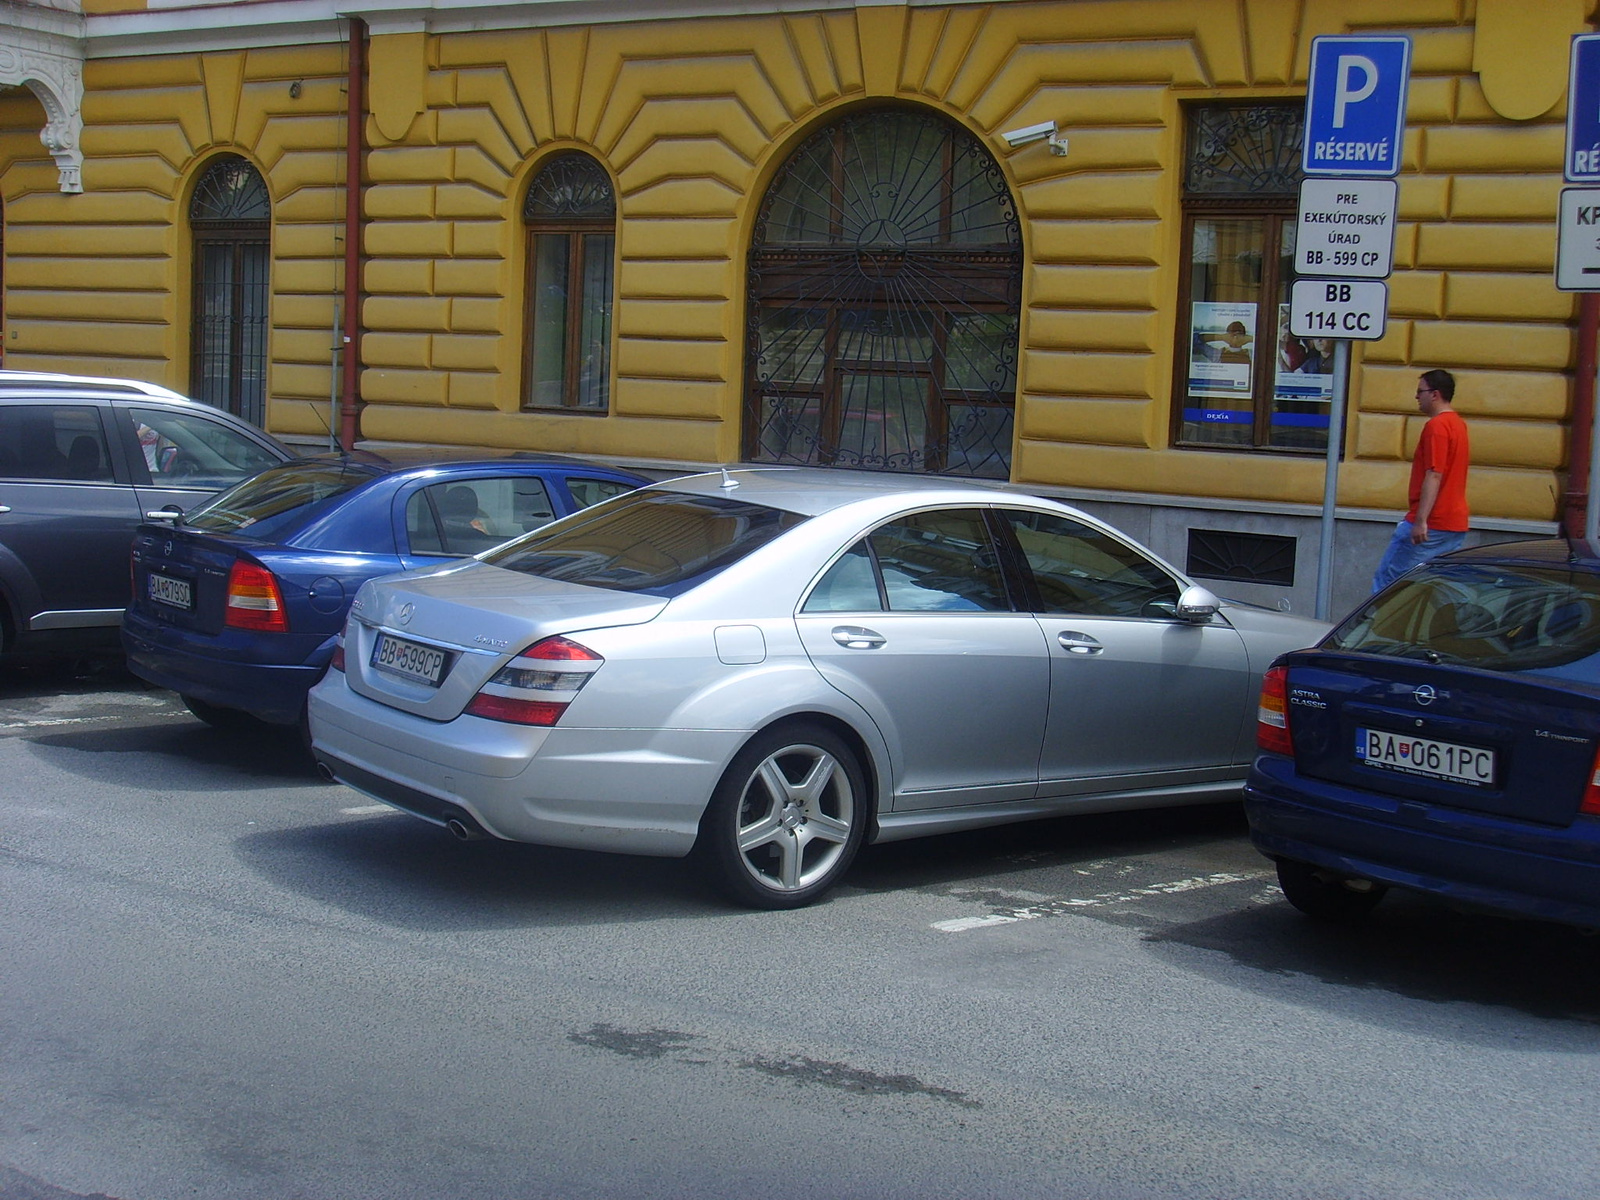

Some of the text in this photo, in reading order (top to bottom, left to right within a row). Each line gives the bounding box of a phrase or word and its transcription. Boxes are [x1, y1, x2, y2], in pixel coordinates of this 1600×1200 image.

[1332, 55, 1378, 128] P
[1314, 136, 1389, 161] RÉSERVÉ
[1336, 193, 1358, 205] PRE
[1304, 210, 1387, 226] EXEKÚTORSKÝ
[1328, 230, 1361, 245] ÚRAD
[1306, 250, 1323, 265] BB
[1333, 251, 1358, 266] 599
[1361, 252, 1379, 267] CP
[1325, 284, 1351, 302] BB
[1305, 311, 1371, 332] 114 CC
[1292, 689, 1321, 700] ASTRA
[1290, 697, 1327, 710] CLASSIC
